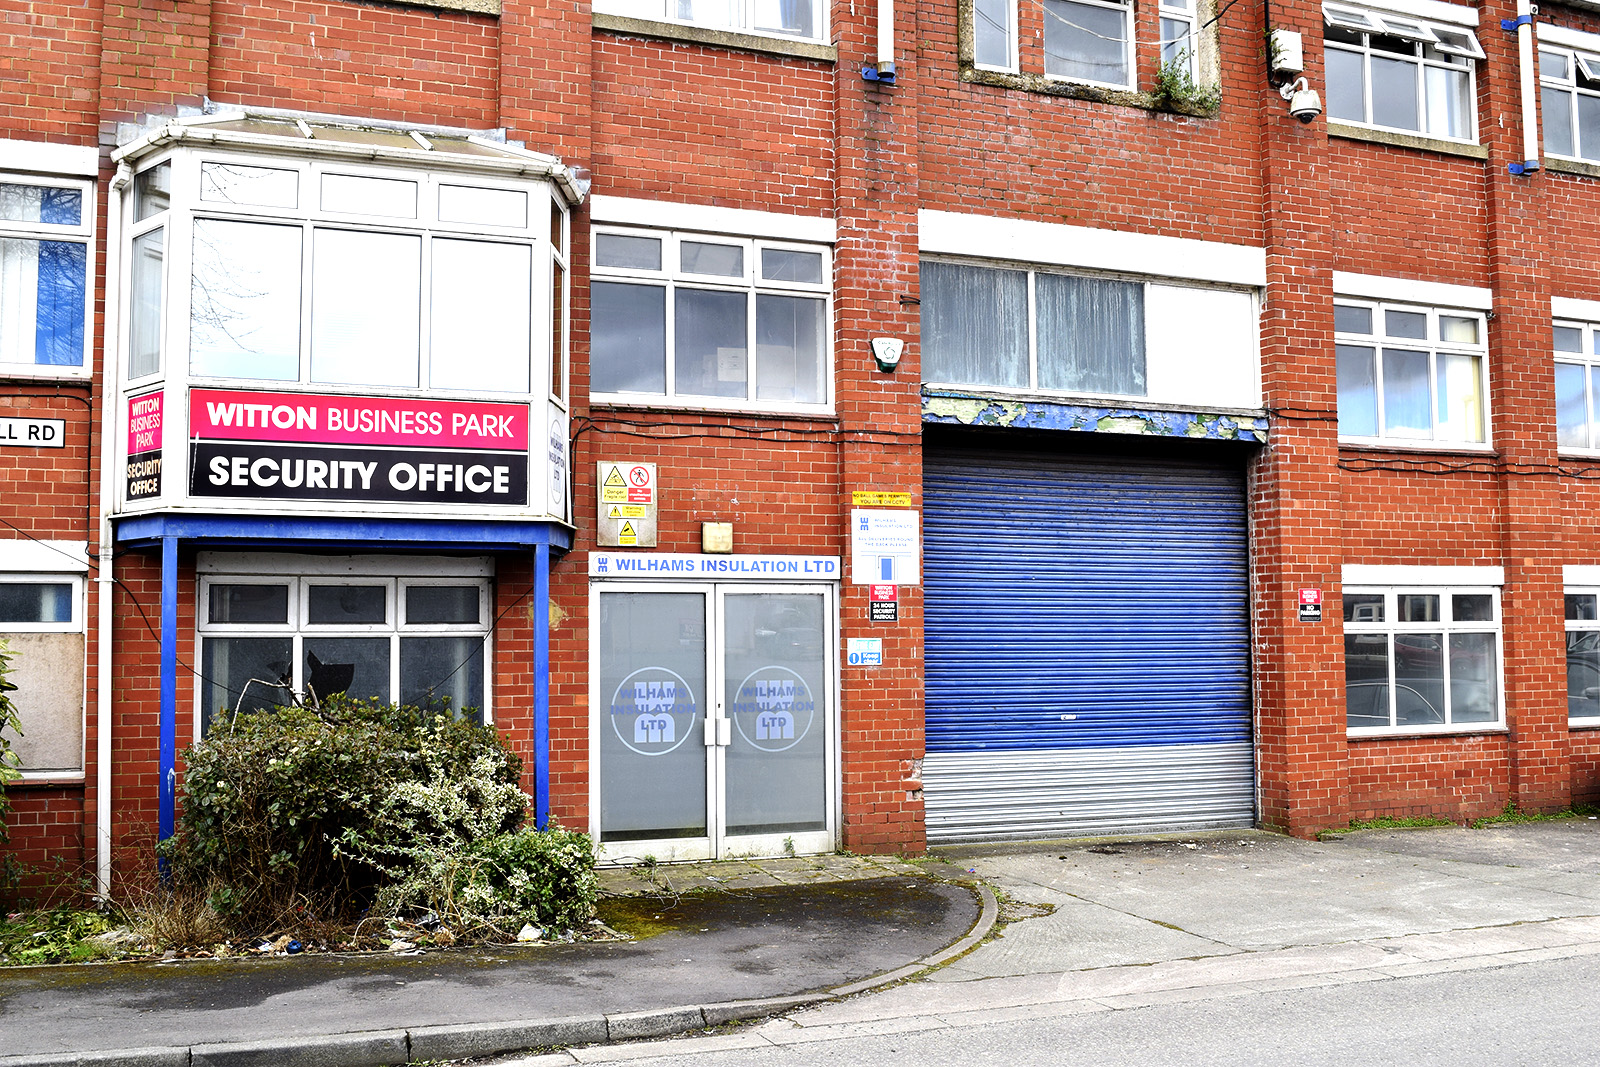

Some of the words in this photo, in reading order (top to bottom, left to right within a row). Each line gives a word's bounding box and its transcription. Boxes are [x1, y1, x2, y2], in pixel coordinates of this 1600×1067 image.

[131, 397, 160, 416] WITTON
[130, 413, 161, 433] BUSINESS
[206, 401, 317, 430] WITTON
[327, 407, 443, 435] BUSINESS
[452, 412, 515, 438] PARK
[28, 425, 55, 440] RD
[136, 431, 154, 449] PARK
[127, 459, 162, 479] SECURITY
[208, 455, 379, 490] SECURITY
[388, 461, 510, 494] OFFICE
[130, 478, 158, 496] OFFICE
[615, 558, 695, 572] WILHAMS
[701, 559, 798, 573] INSULATION
[804, 560, 835, 573] LTD
[619, 688, 687, 699] WILHAMS
[742, 686, 805, 697] WILHAMS
[610, 703, 696, 715] INSULATION
[733, 701, 815, 713] INSULATION
[640, 719, 667, 731] LTD
[761, 717, 787, 728] LTD
